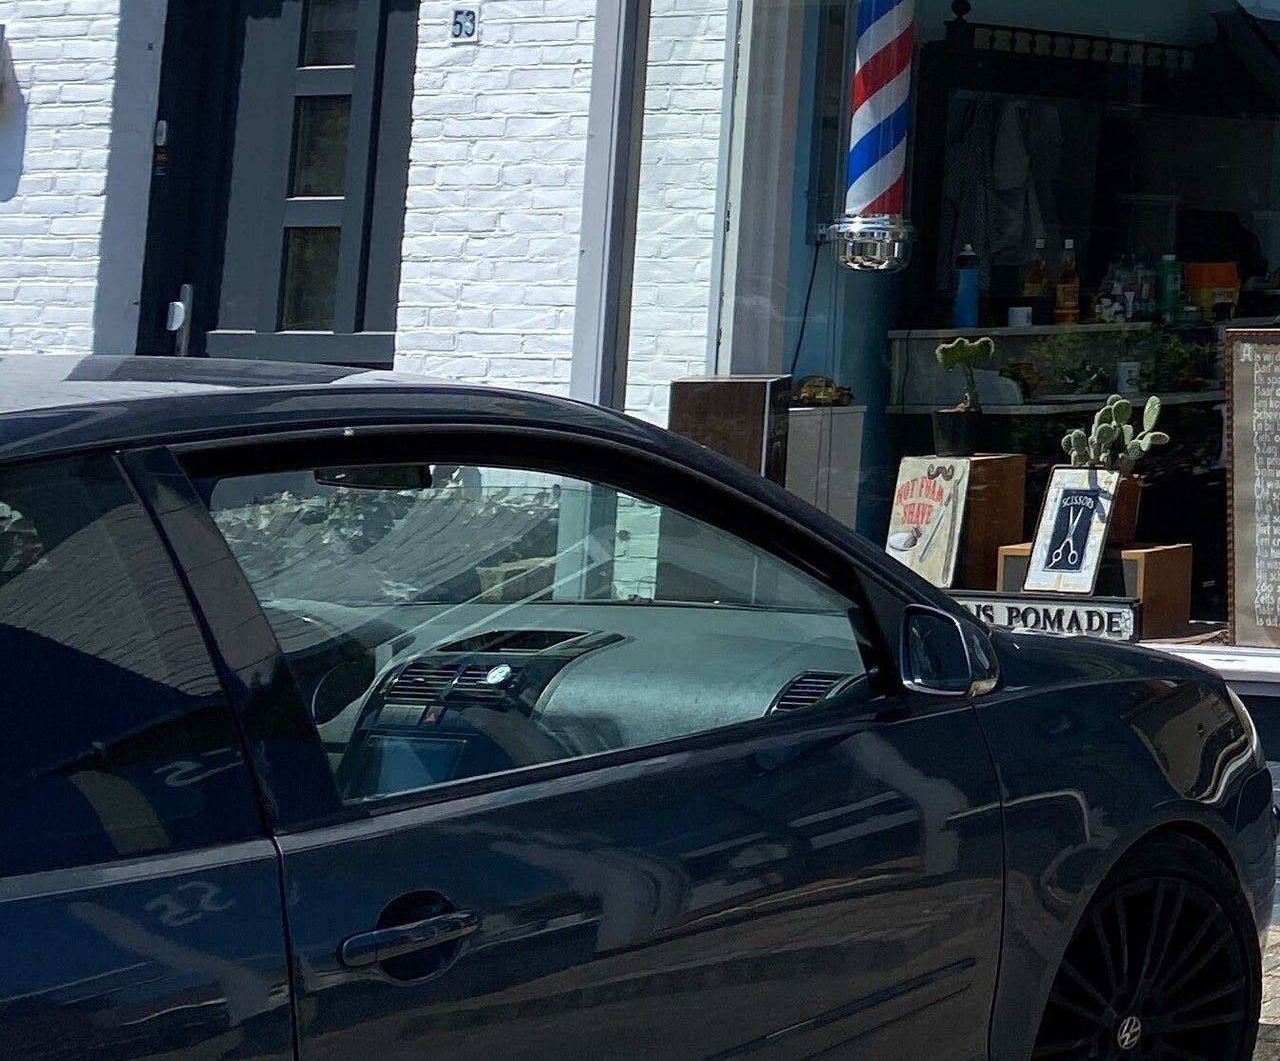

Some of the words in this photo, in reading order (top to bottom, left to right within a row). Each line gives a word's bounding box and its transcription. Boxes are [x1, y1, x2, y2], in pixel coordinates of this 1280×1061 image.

[452, 10, 476, 38] 53
[895, 477, 919, 505] HOT
[919, 476, 945, 506] FOAM
[902, 503, 933, 525] SHAVE
[1007, 606, 1123, 633] POMADE
